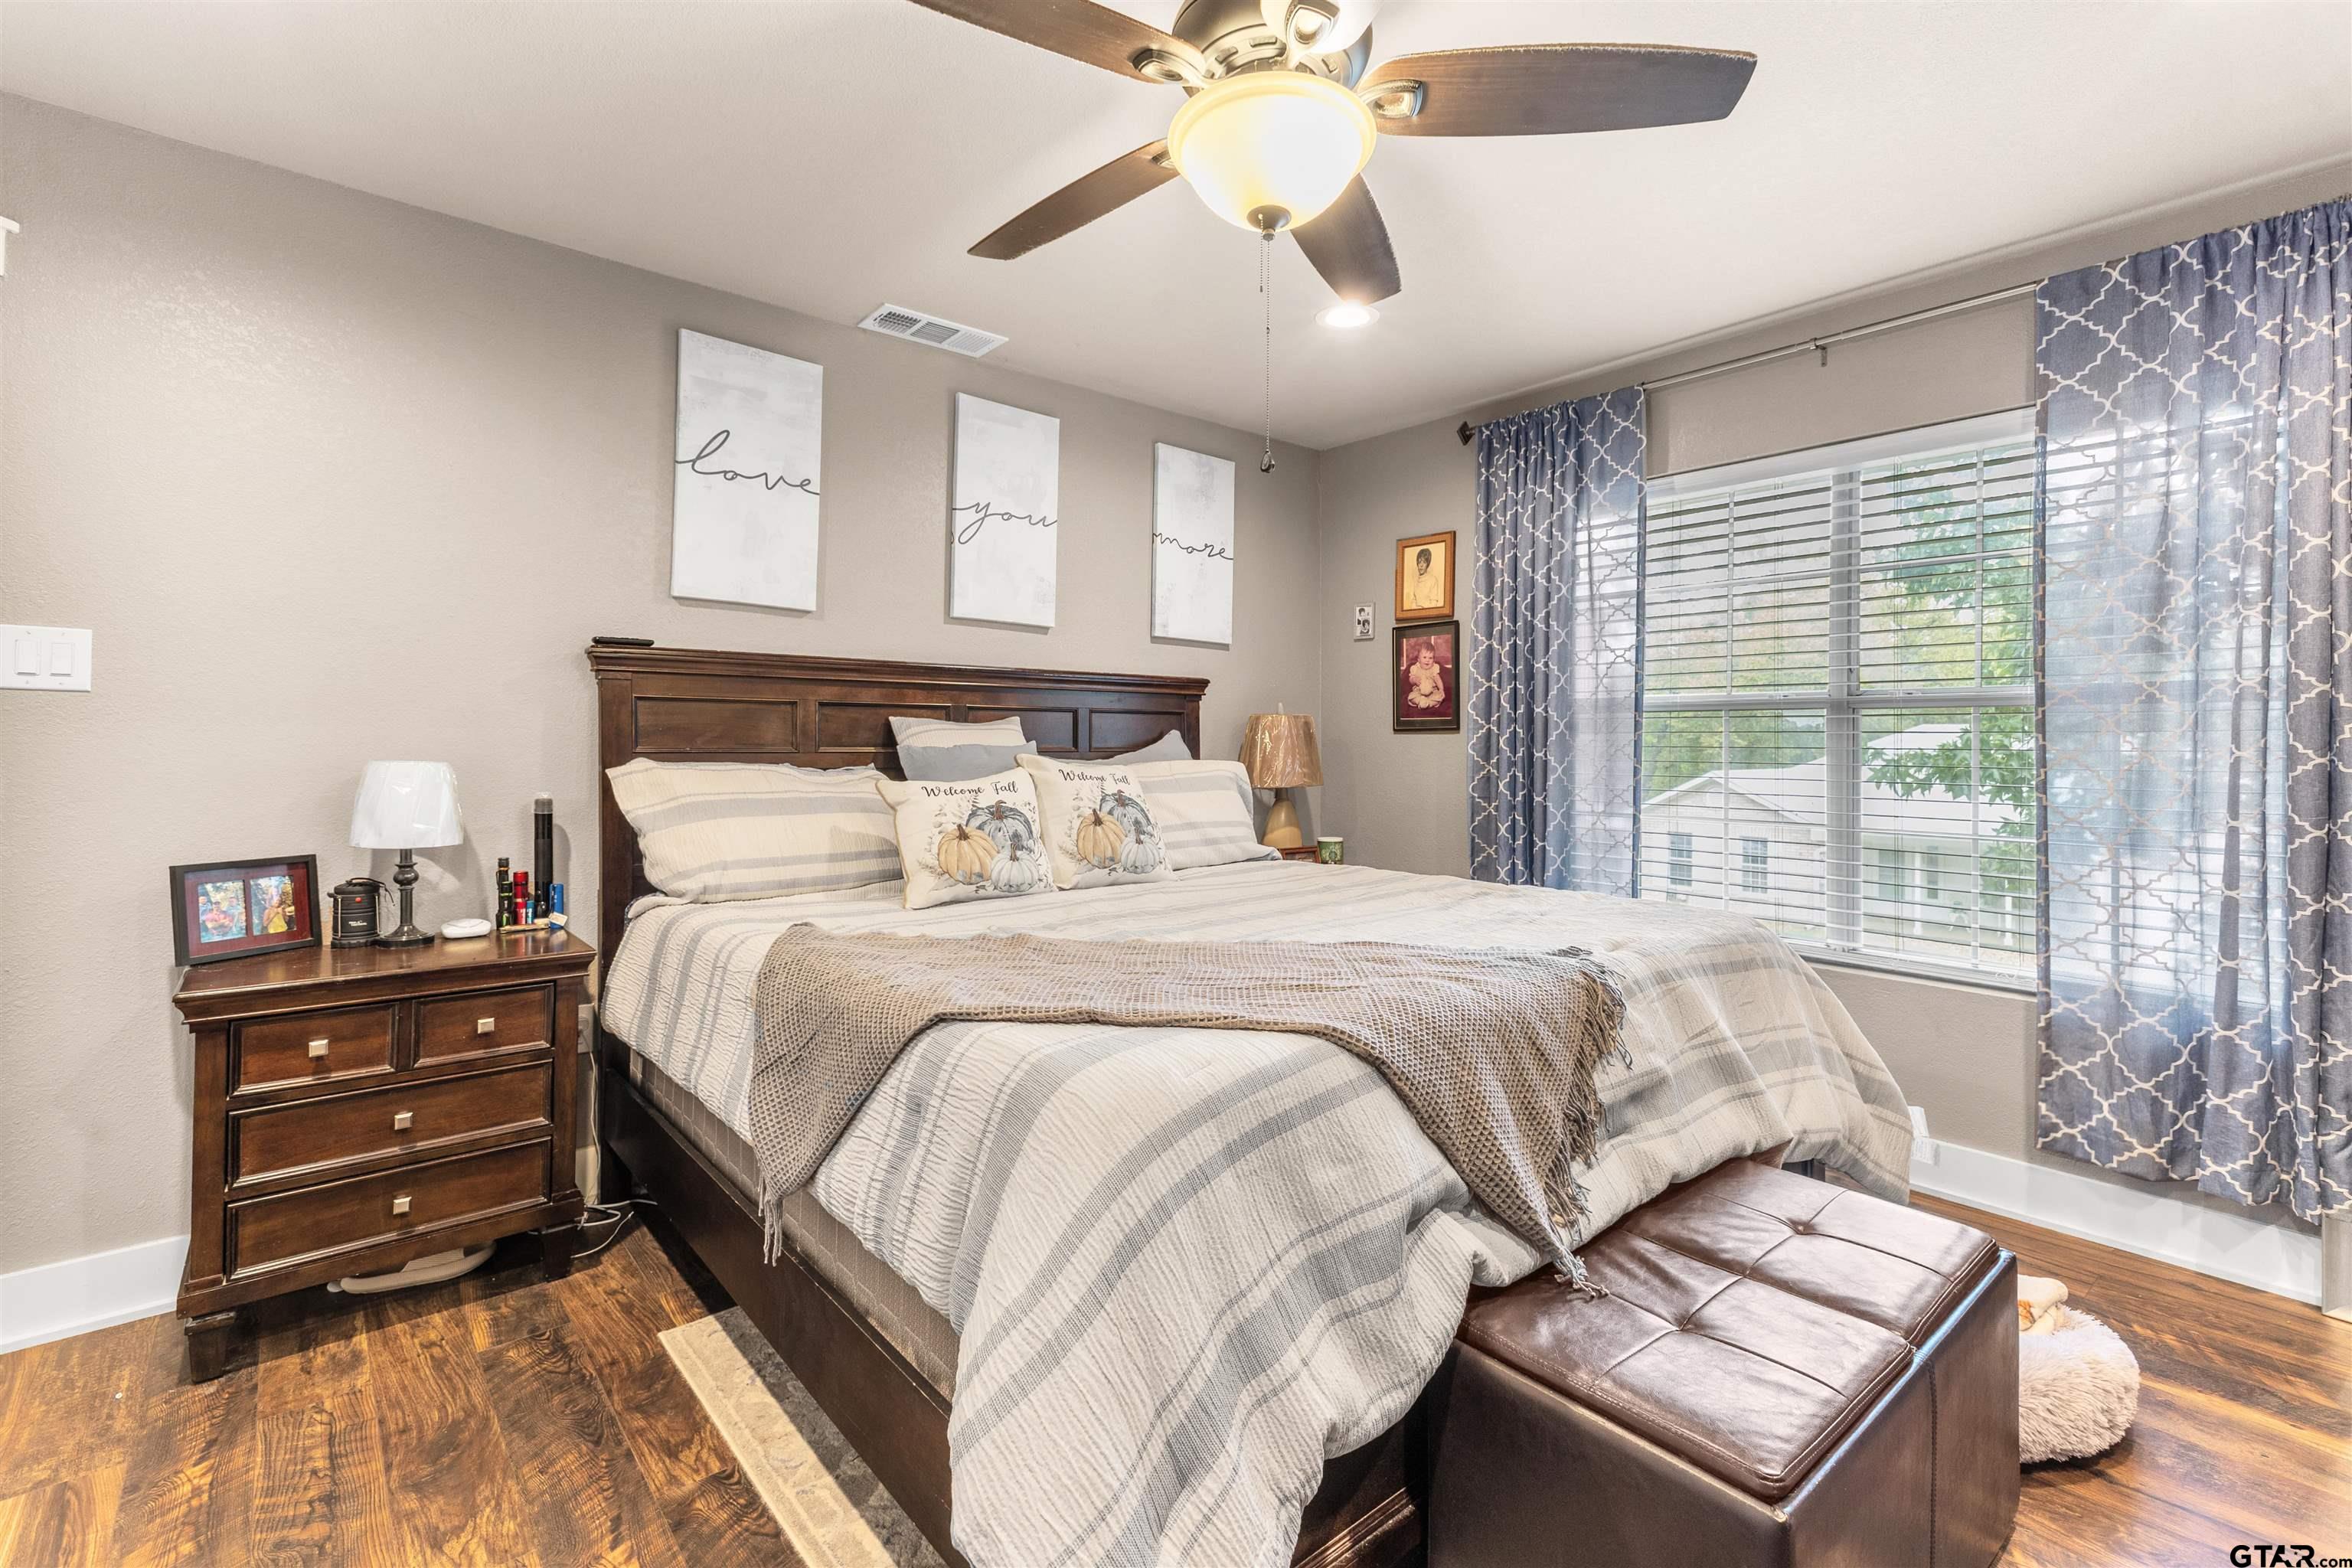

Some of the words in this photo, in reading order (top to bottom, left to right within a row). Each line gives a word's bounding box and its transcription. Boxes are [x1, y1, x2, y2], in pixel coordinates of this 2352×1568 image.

[675, 430, 820, 495] love
[952, 501, 1057, 544] you
[1152, 532, 1233, 560] more
[921, 786, 985, 797] Welcome
[991, 780, 1018, 795] Fall
[1058, 769, 1107, 782] Welcome
[1109, 773, 1130, 785] Fall
